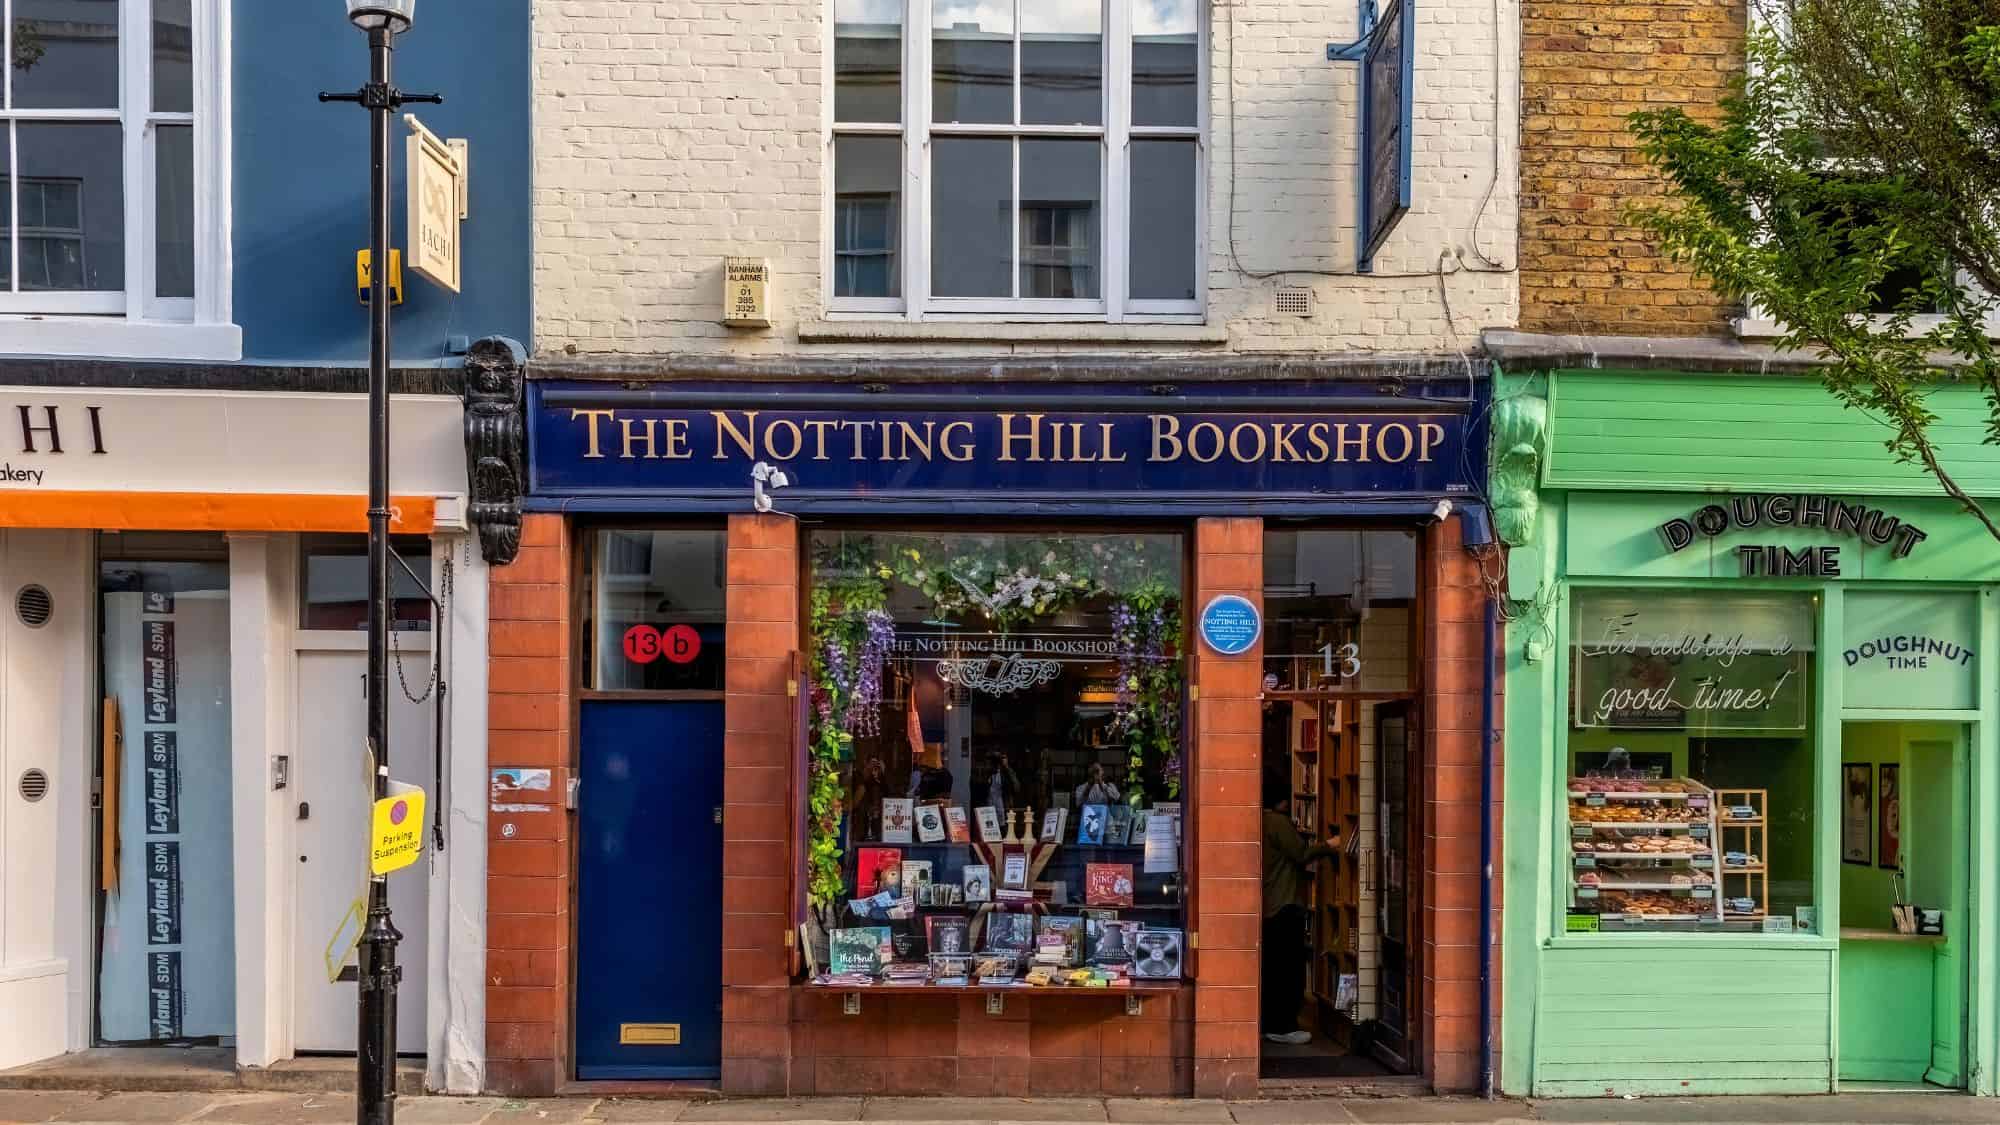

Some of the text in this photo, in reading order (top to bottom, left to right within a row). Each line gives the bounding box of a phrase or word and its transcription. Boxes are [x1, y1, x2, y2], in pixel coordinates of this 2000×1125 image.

[727, 265, 764, 274] BANHAM
[728, 273, 763, 282] ALARMS
[740, 288, 752, 296] 01
[571, 408, 1445, 463] THE NOTTING HILL BOOKSHOP
[1655, 495, 1928, 561] DOUGHNUT
[1733, 545, 1841, 577] TIME
[915, 638, 990, 653] NOTTING
[992, 638, 1026, 653] HILL
[1032, 639, 1118, 654] BOOKSHOP
[1317, 642, 1362, 678] 13
[1842, 635, 1976, 667] DOUGHNUT
[146, 621, 169, 723] Leyland SDM
[1886, 655, 1929, 670] TIME
[147, 732, 171, 833] Leyland SDM
[382, 831, 414, 847] Parking
[149, 843, 173, 945] Leyland SDM
[156, 953, 170, 984] SDM
